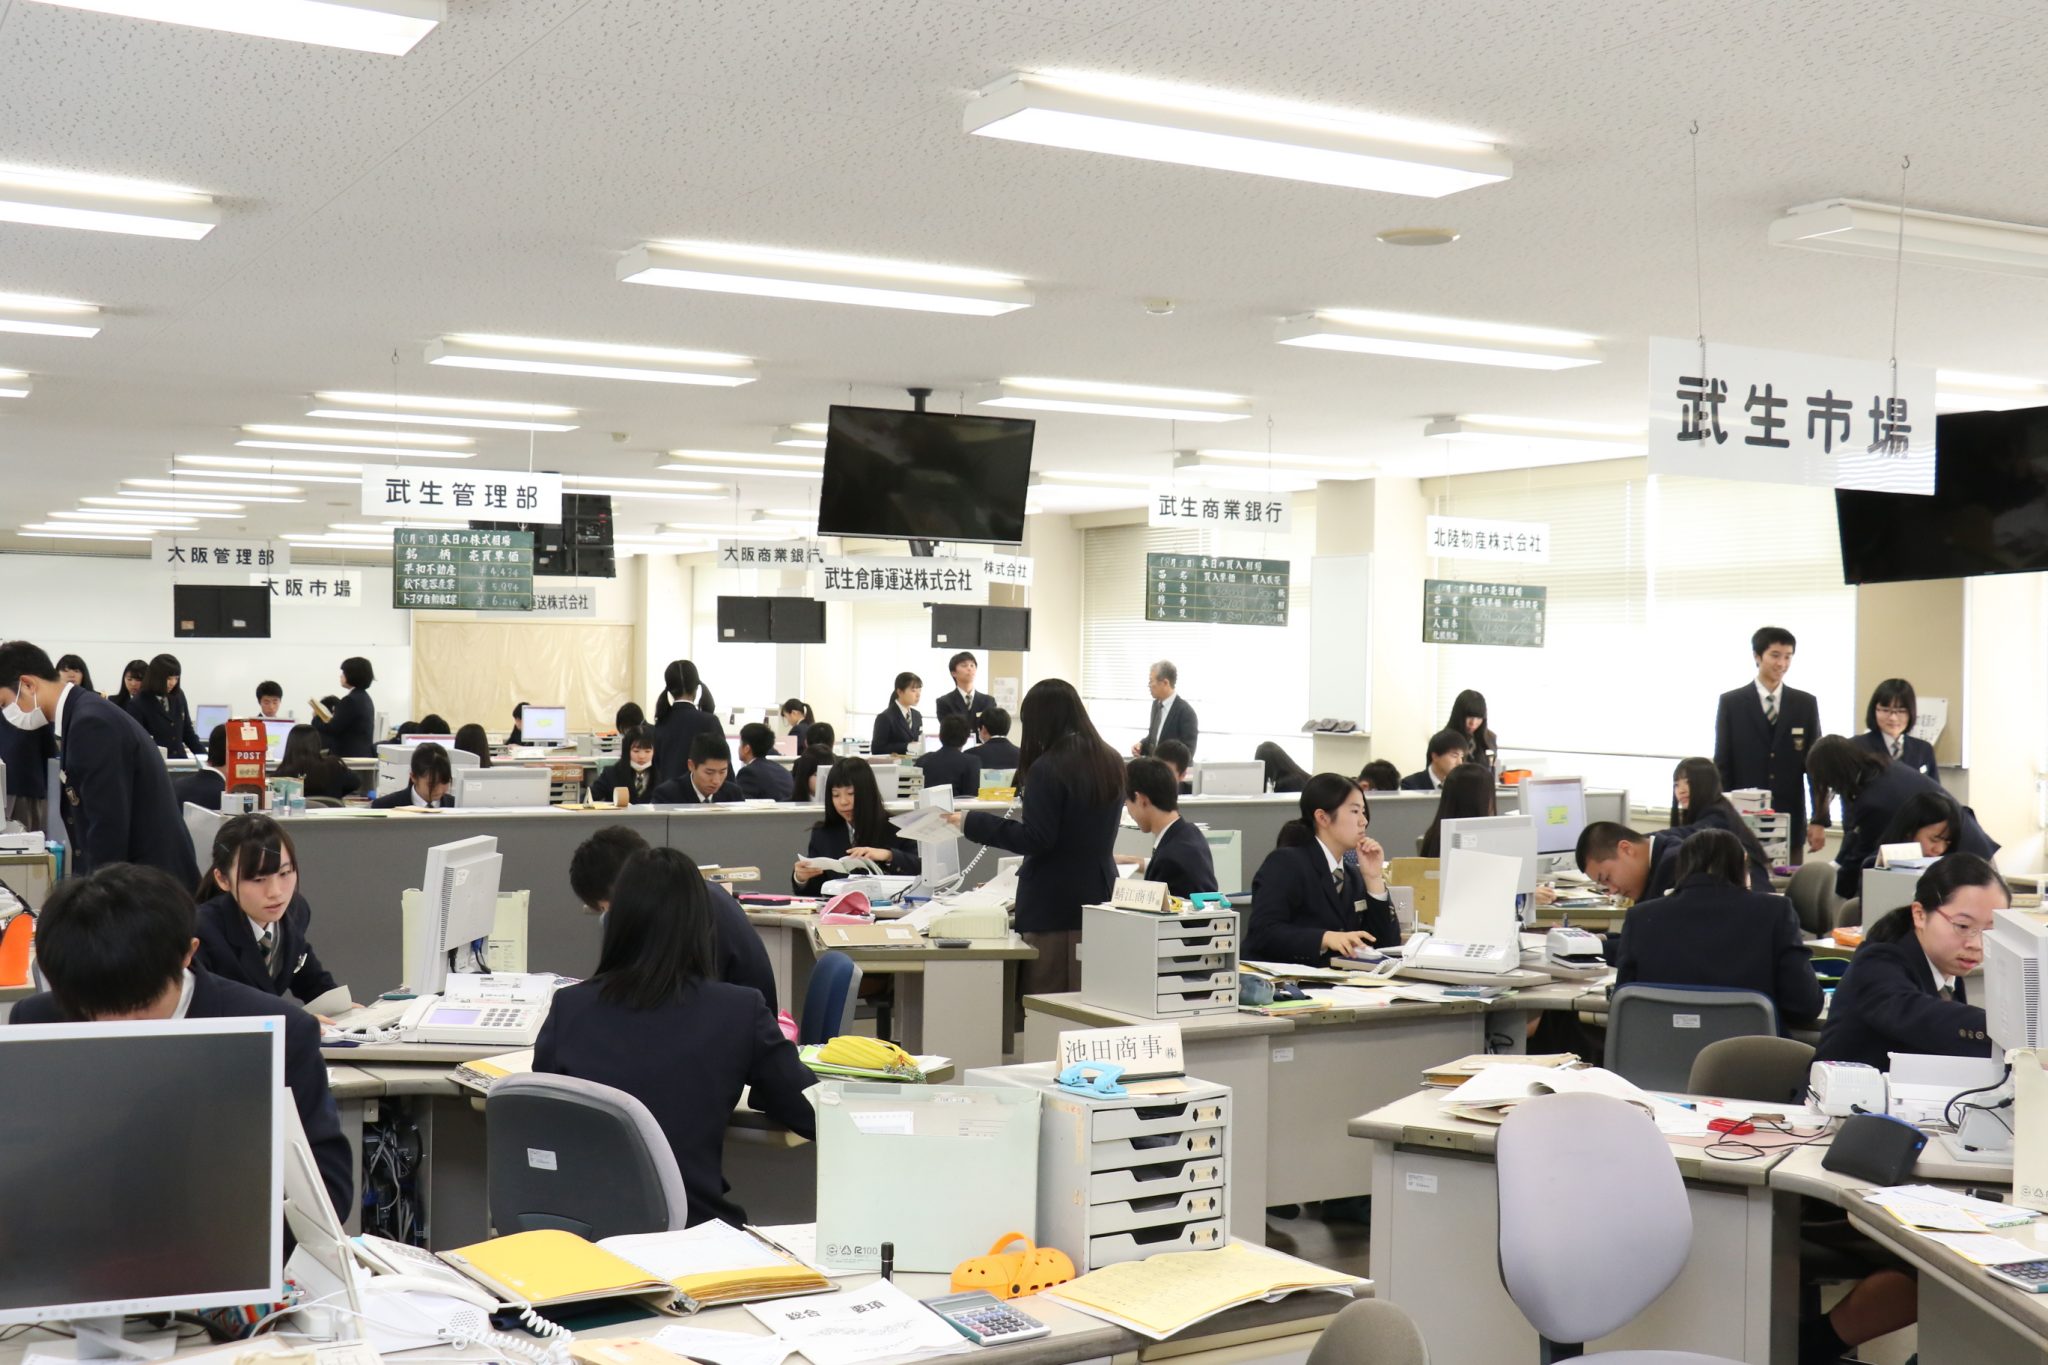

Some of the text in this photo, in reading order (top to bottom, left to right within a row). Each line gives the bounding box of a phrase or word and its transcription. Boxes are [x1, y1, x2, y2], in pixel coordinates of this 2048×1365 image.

[1676, 375, 1912, 459] 武生市場
[385, 478, 539, 510] 武生管理部
[1159, 494, 1283, 523] 武生商業銀行
[1434, 527, 1542, 552] 北陸物産株式会社
[168, 546, 275, 566] 大阪管理部
[724, 546, 820, 563] 大阪商業銀行
[824, 566, 973, 591] 武生倉庫運送株式会社
[983, 560, 1028, 578] 株式会社
[261, 579, 352, 598] 大阪市場
[237, 751, 261, 760] POST
